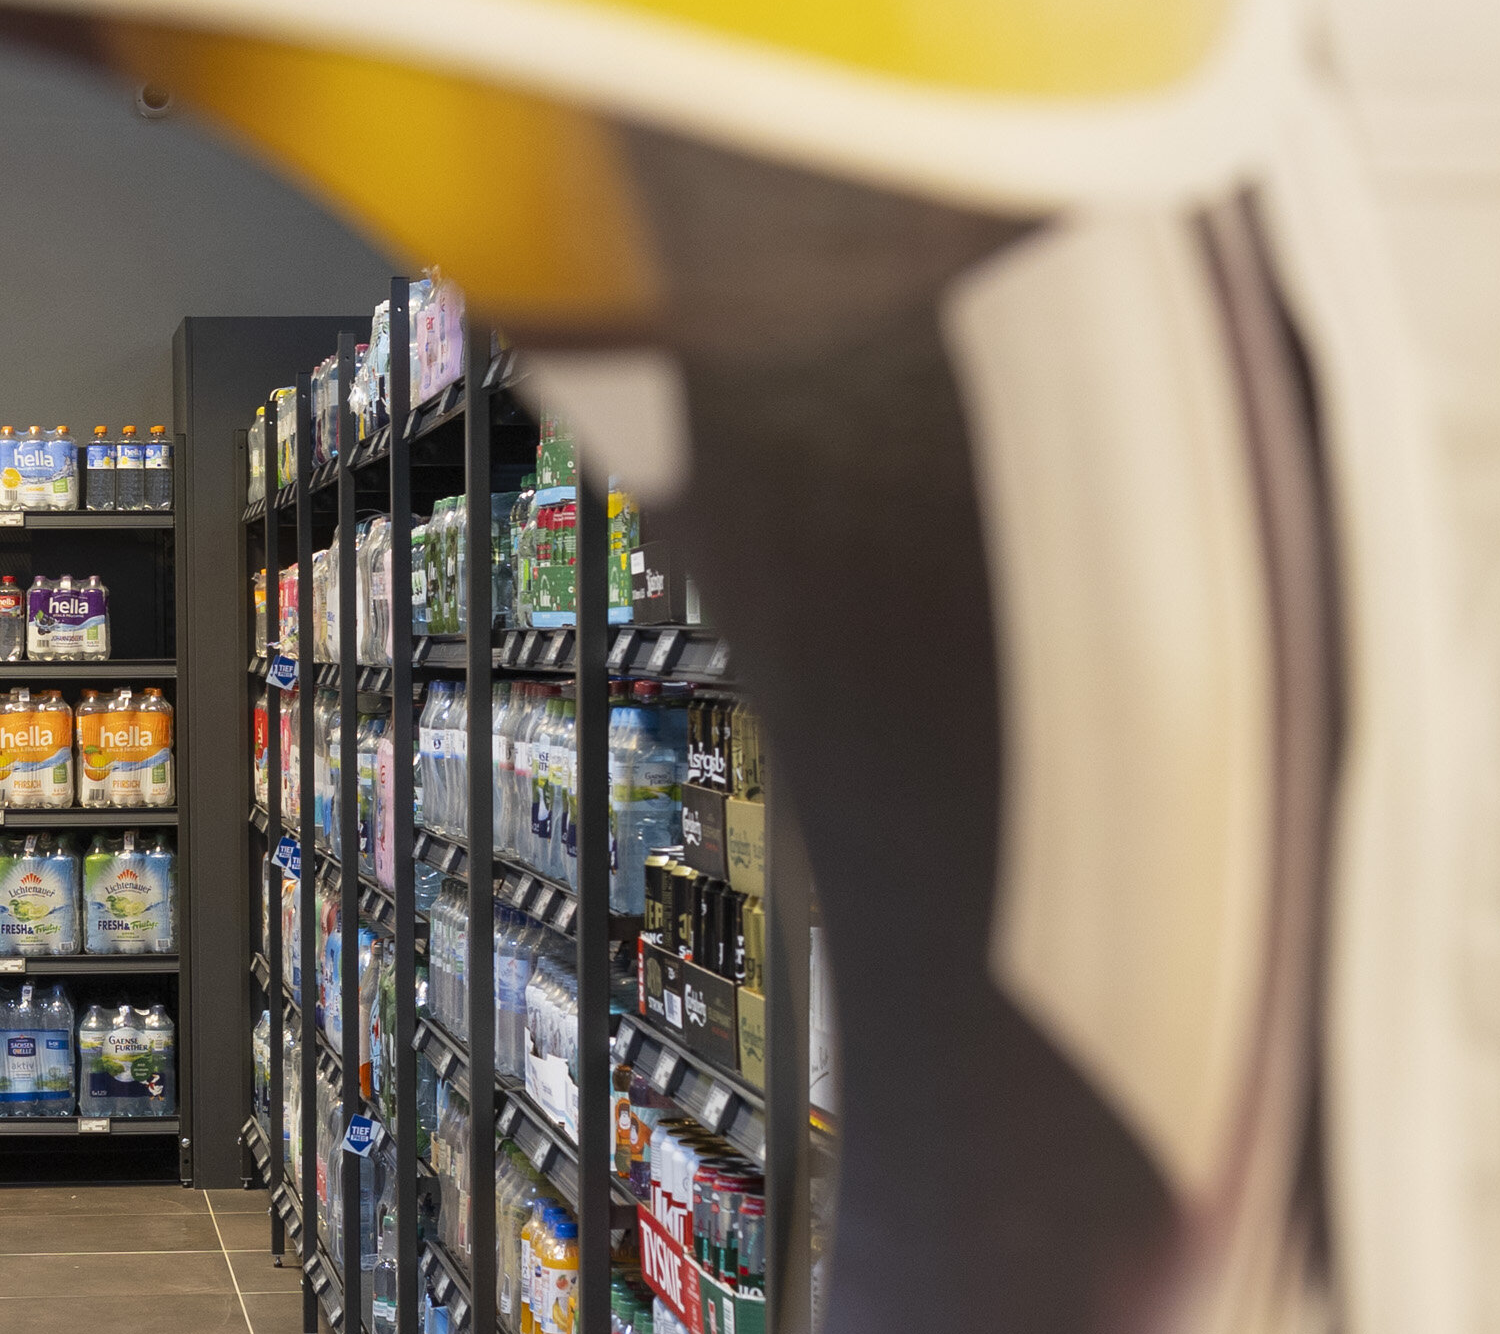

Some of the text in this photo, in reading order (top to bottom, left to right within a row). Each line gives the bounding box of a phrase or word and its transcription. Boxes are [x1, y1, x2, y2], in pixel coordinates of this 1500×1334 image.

[14, 449, 54, 467] hella
[49, 597, 88, 614] hella
[0, 726, 53, 748] hella
[100, 726, 152, 747] hella
[8, 885, 55, 898] Lichtenauer
[105, 881, 151, 895] Lichtenauer
[108, 1035, 138, 1046] GAENSE
[115, 1042, 148, 1052] FURTHER
[10, 1061, 34, 1070] aktiv
[351, 1126, 371, 1135] TIEF
[640, 1217, 686, 1315] TYSKIE
